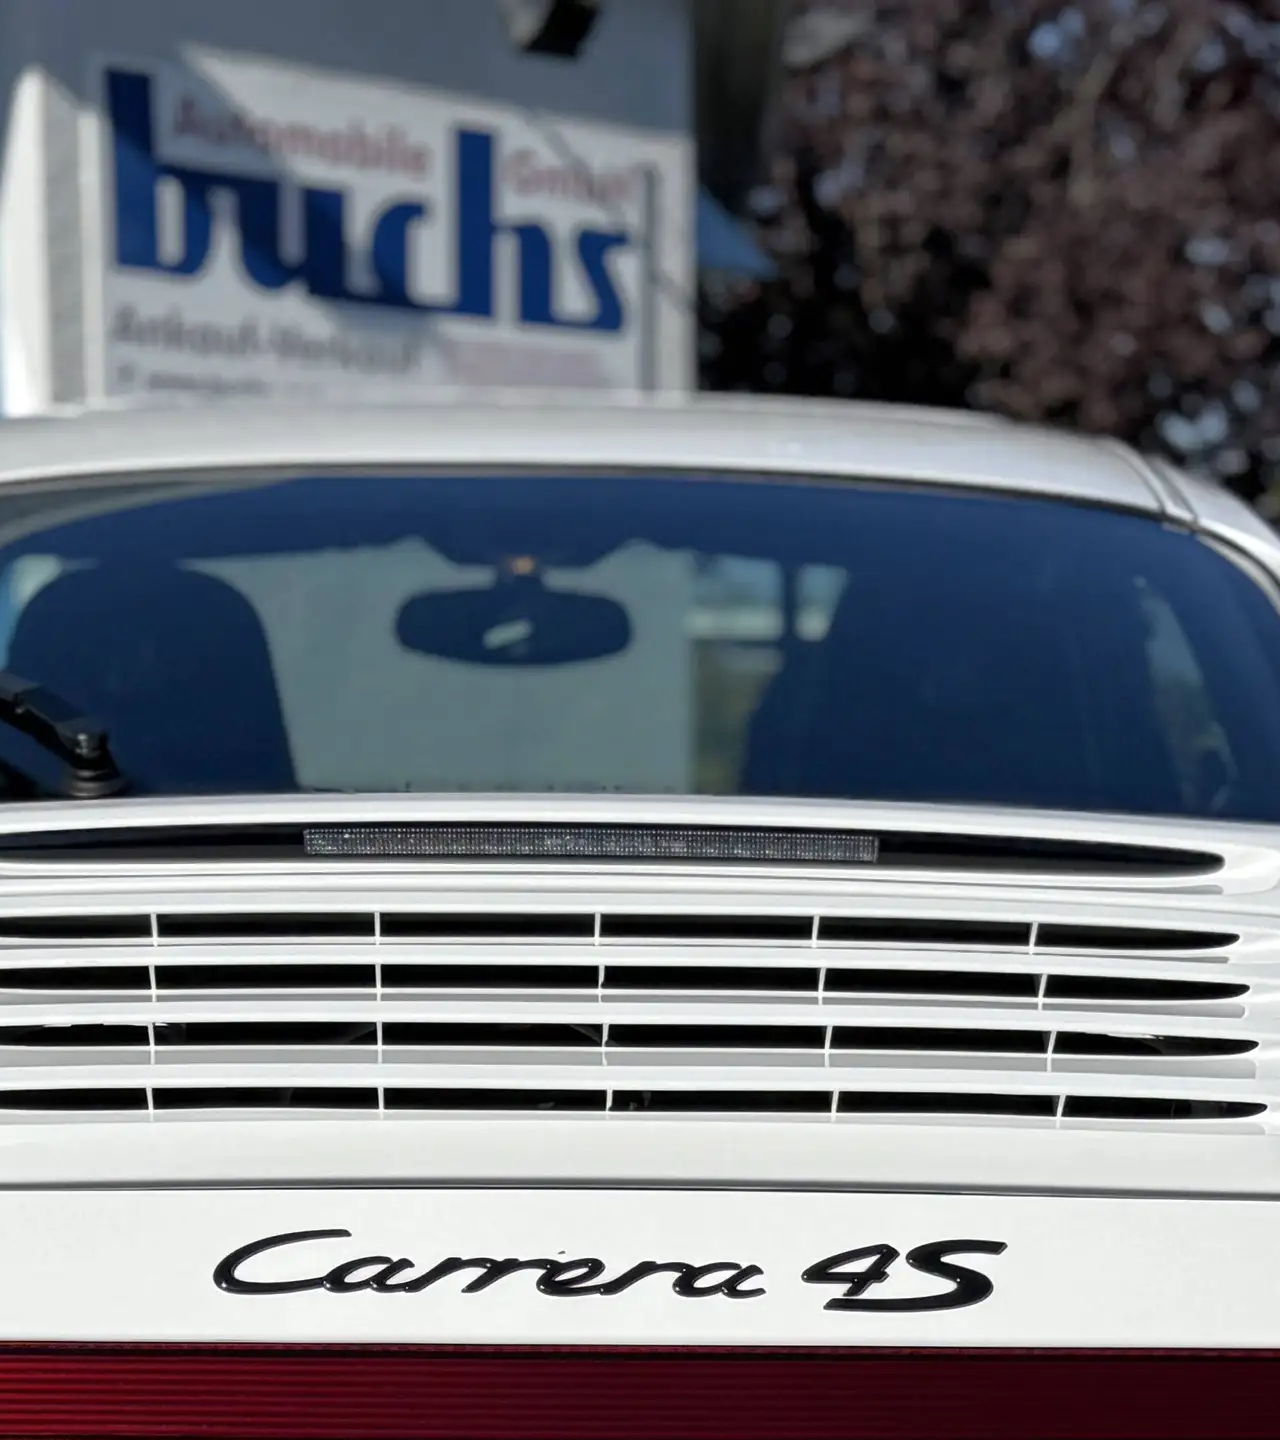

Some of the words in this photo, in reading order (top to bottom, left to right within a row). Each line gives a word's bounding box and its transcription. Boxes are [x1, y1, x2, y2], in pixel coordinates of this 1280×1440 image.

[107, 68, 629, 334] buchs
[213, 1228, 766, 1298] Carrera
[801, 1240, 1008, 1313] 4S
